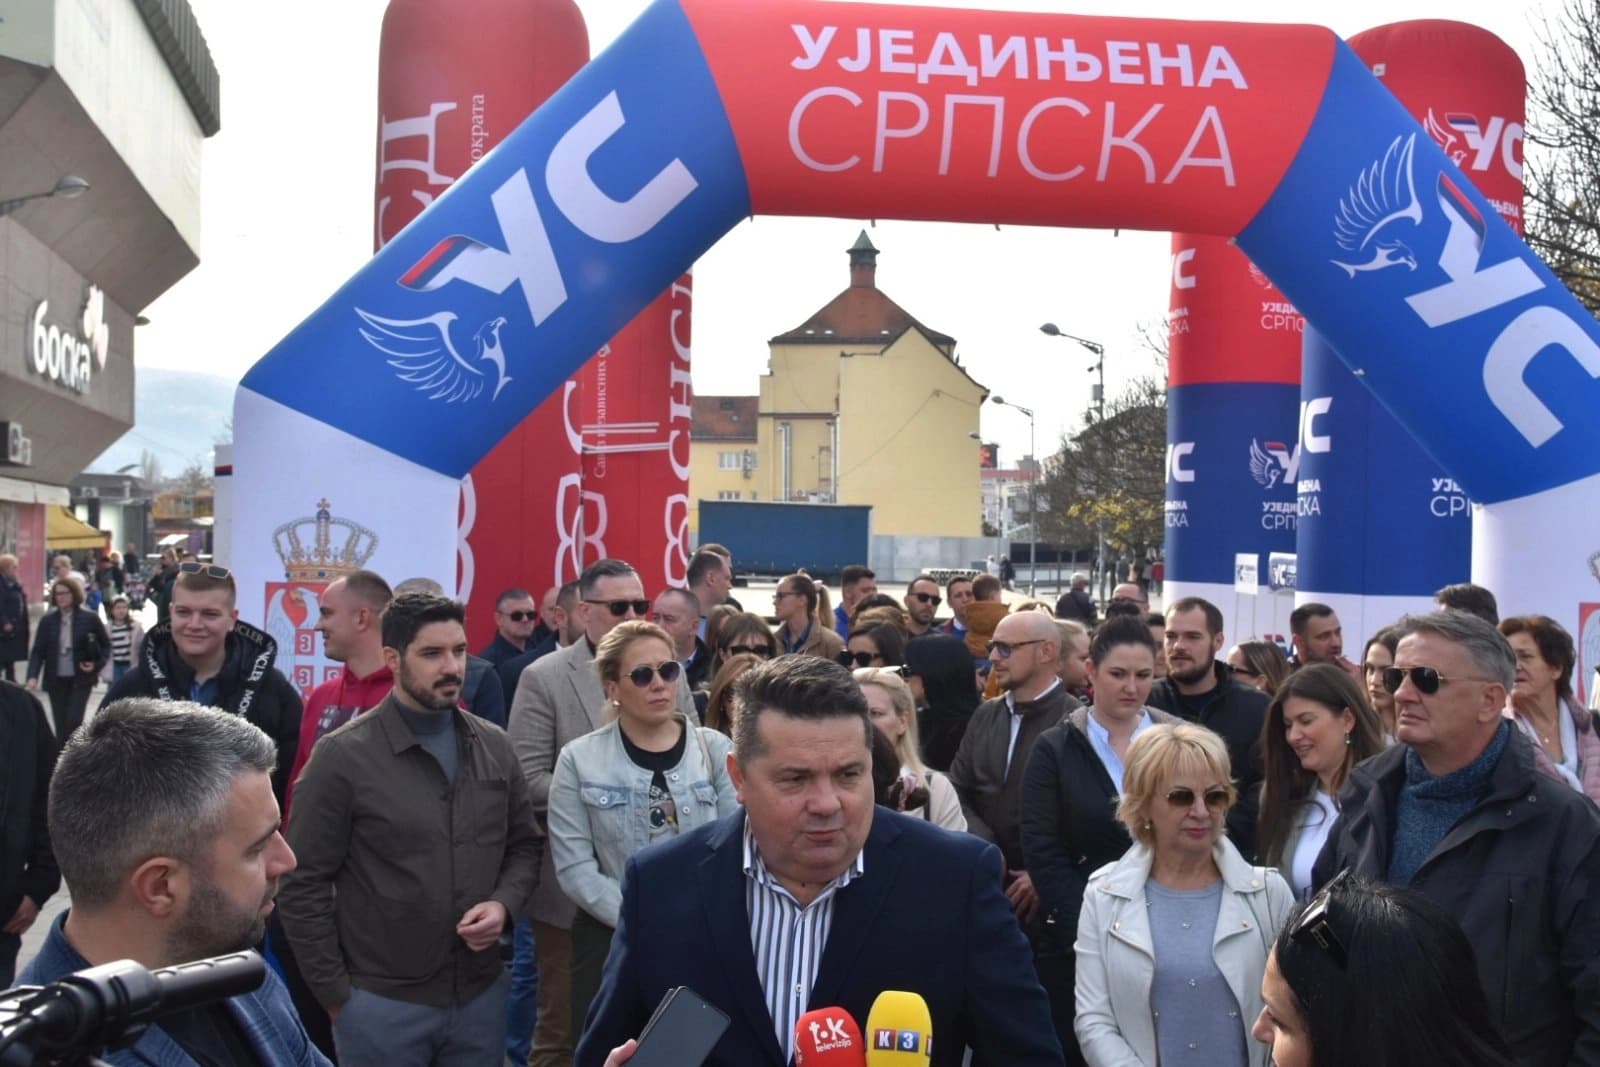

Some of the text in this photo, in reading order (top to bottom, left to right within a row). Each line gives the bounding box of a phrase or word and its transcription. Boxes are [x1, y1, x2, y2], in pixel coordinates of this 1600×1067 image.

[790, 24, 1248, 89] УЈЕДИЊЕНА
[471, 94, 488, 165] ократа
[788, 86, 1236, 187] СРПСКА
[397, 88, 699, 328] УС
[1171, 248, 1196, 289] С
[1404, 171, 1600, 449] УС
